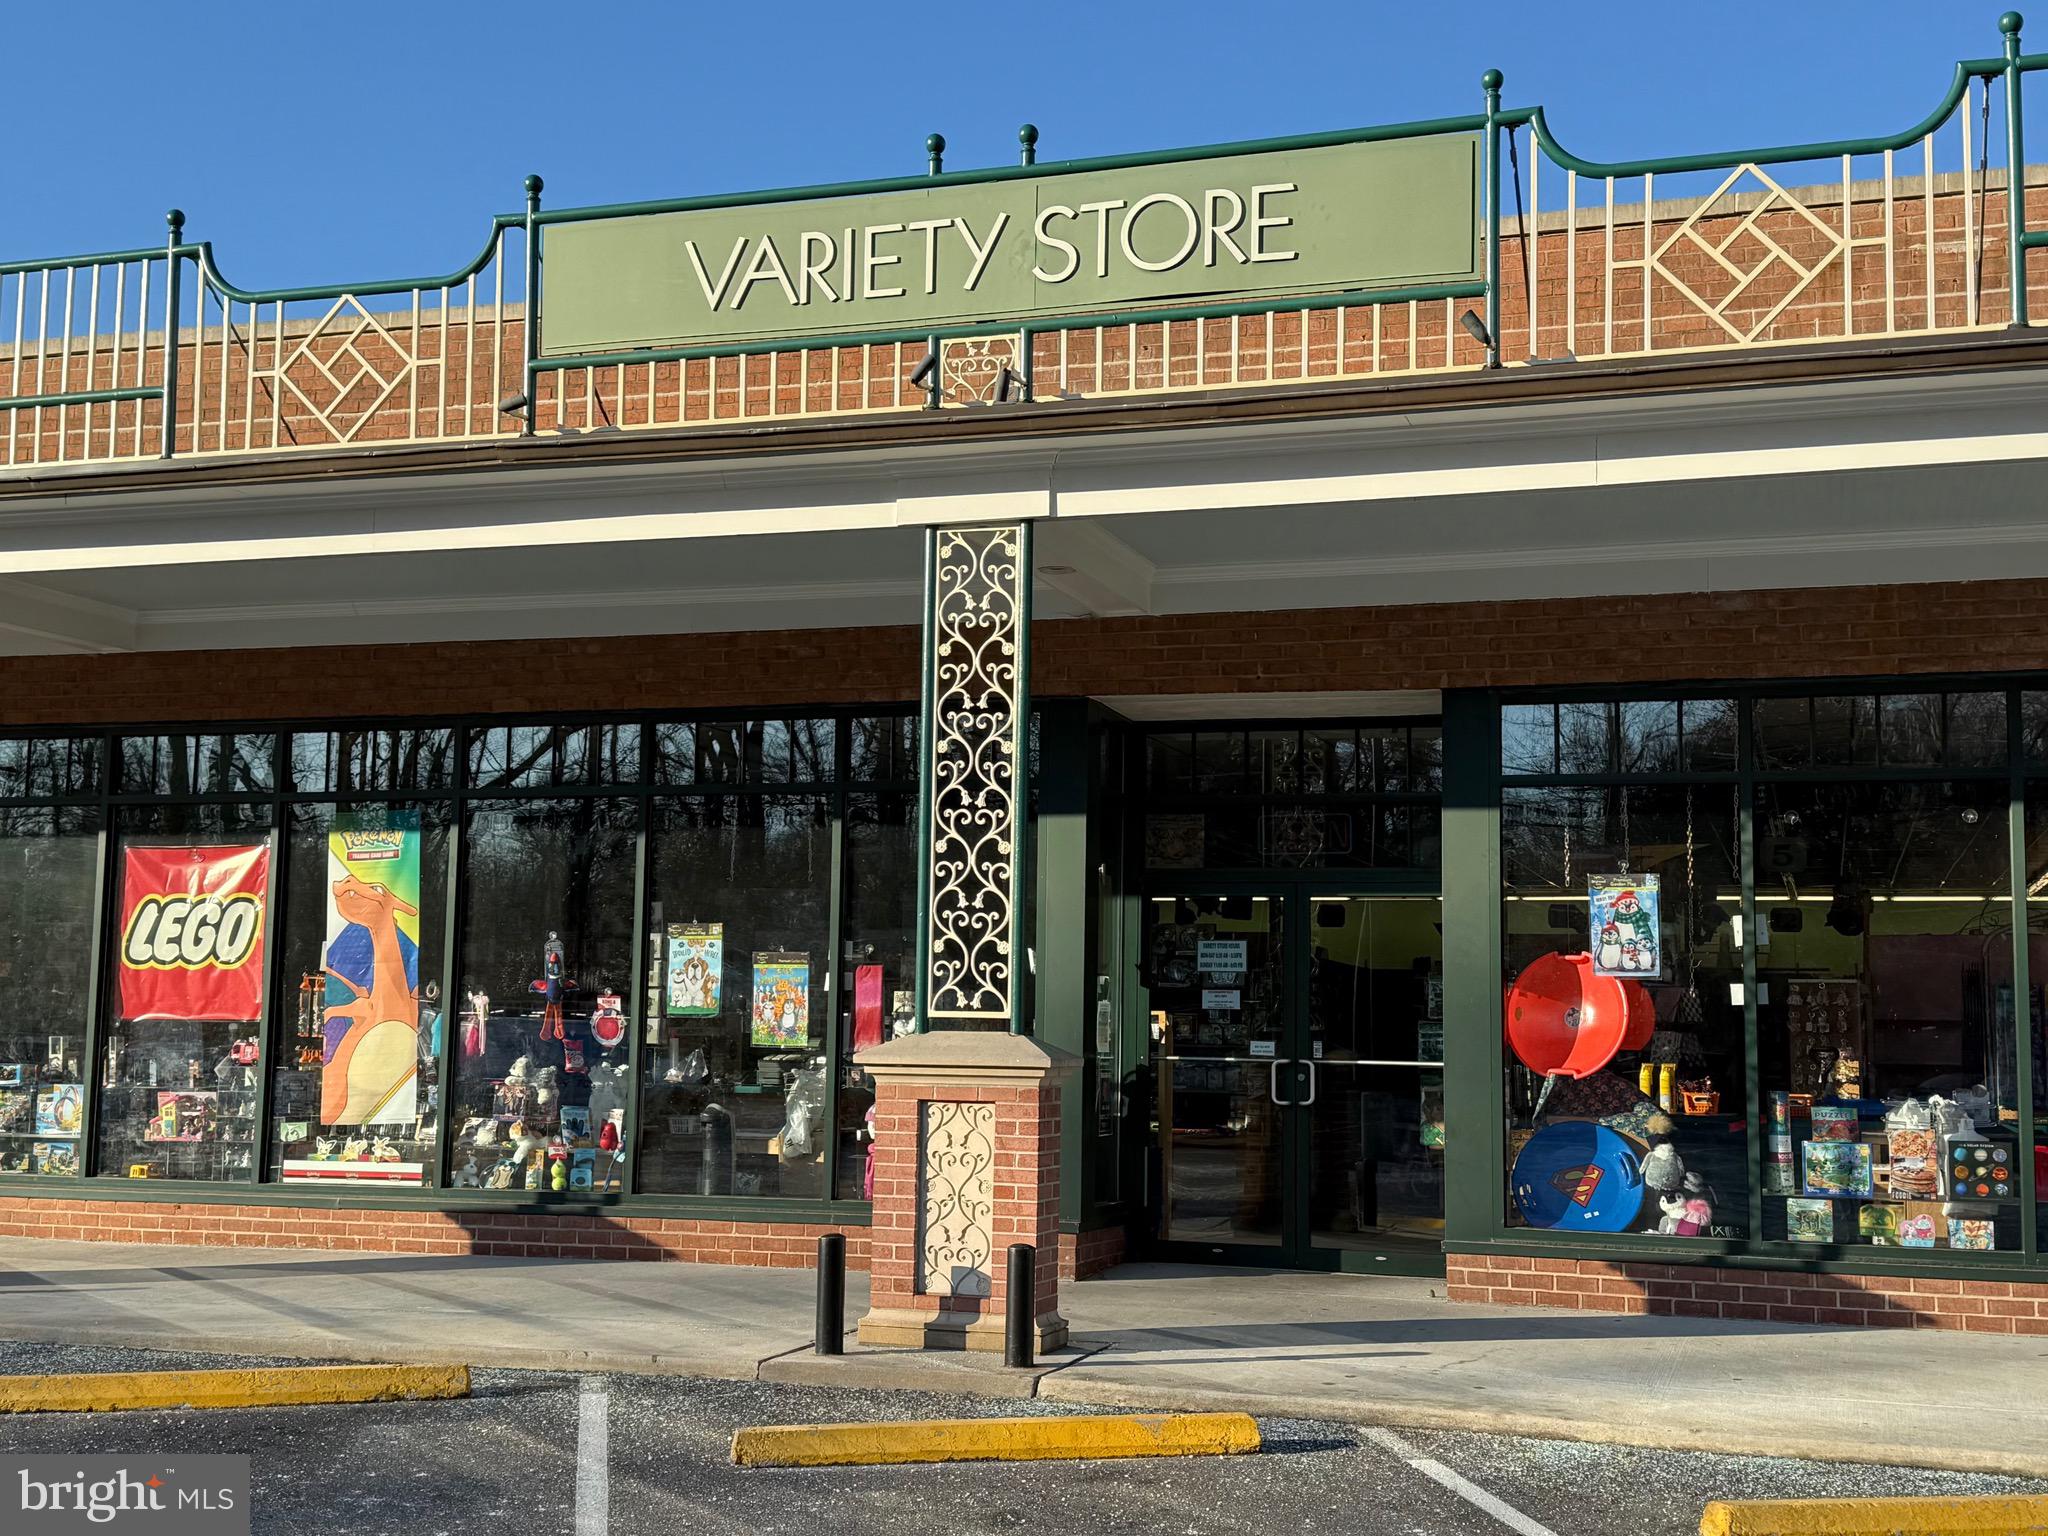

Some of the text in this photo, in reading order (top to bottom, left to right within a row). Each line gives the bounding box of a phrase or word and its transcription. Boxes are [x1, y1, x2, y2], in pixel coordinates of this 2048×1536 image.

[685, 182, 1299, 312] VARIETY STORE
[128, 901, 257, 963] LEGO
